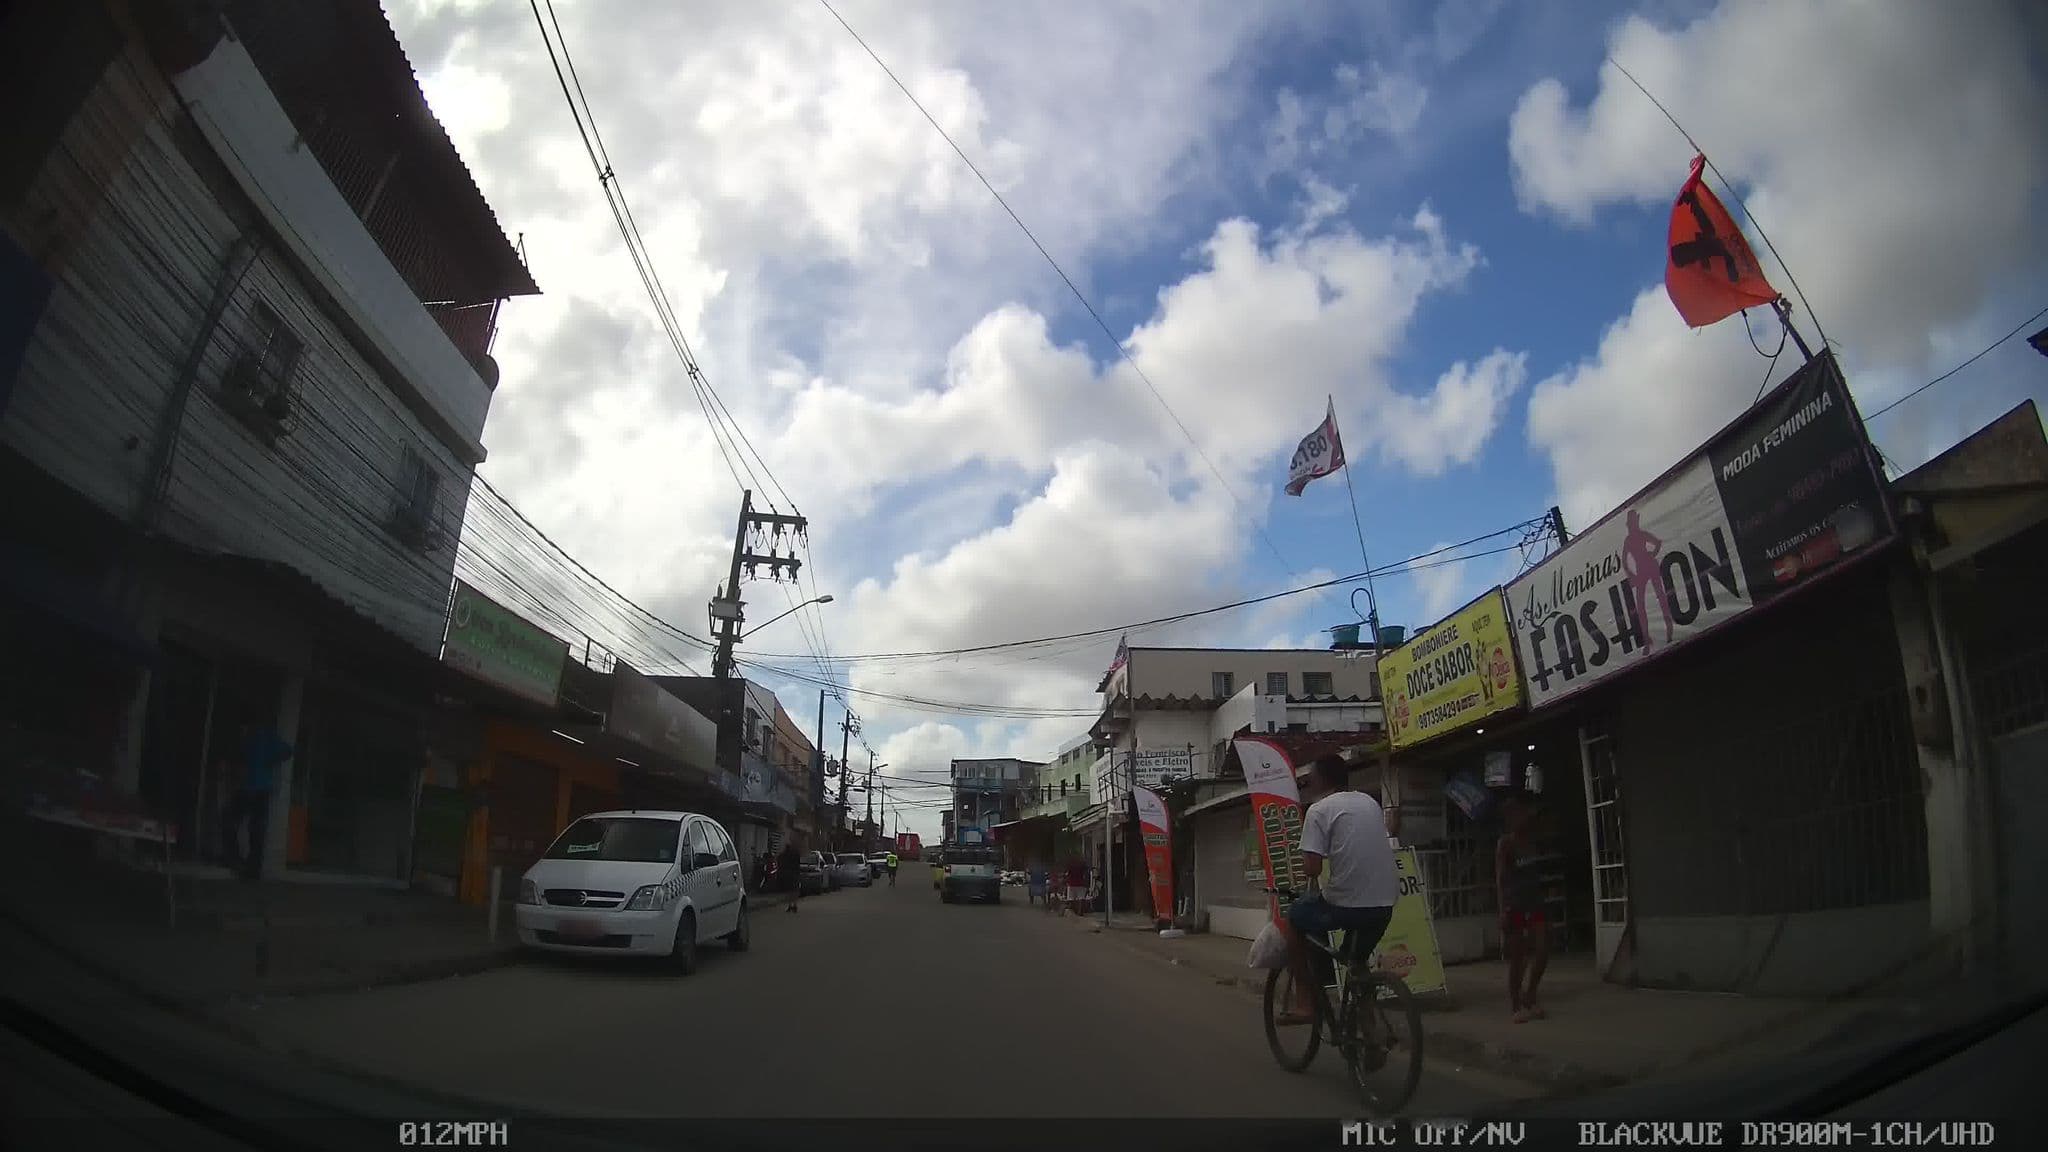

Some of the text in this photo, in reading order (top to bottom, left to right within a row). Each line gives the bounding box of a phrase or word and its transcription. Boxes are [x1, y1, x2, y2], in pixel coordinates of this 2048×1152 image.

[1722, 391, 1833, 482] MODA FEMININA
[1543, 548, 1623, 613] Meninas
[1406, 662, 1435, 700] DOCE
[1435, 642, 1476, 687] SABOR
[1411, 624, 1459, 663] BOMBONIERE
